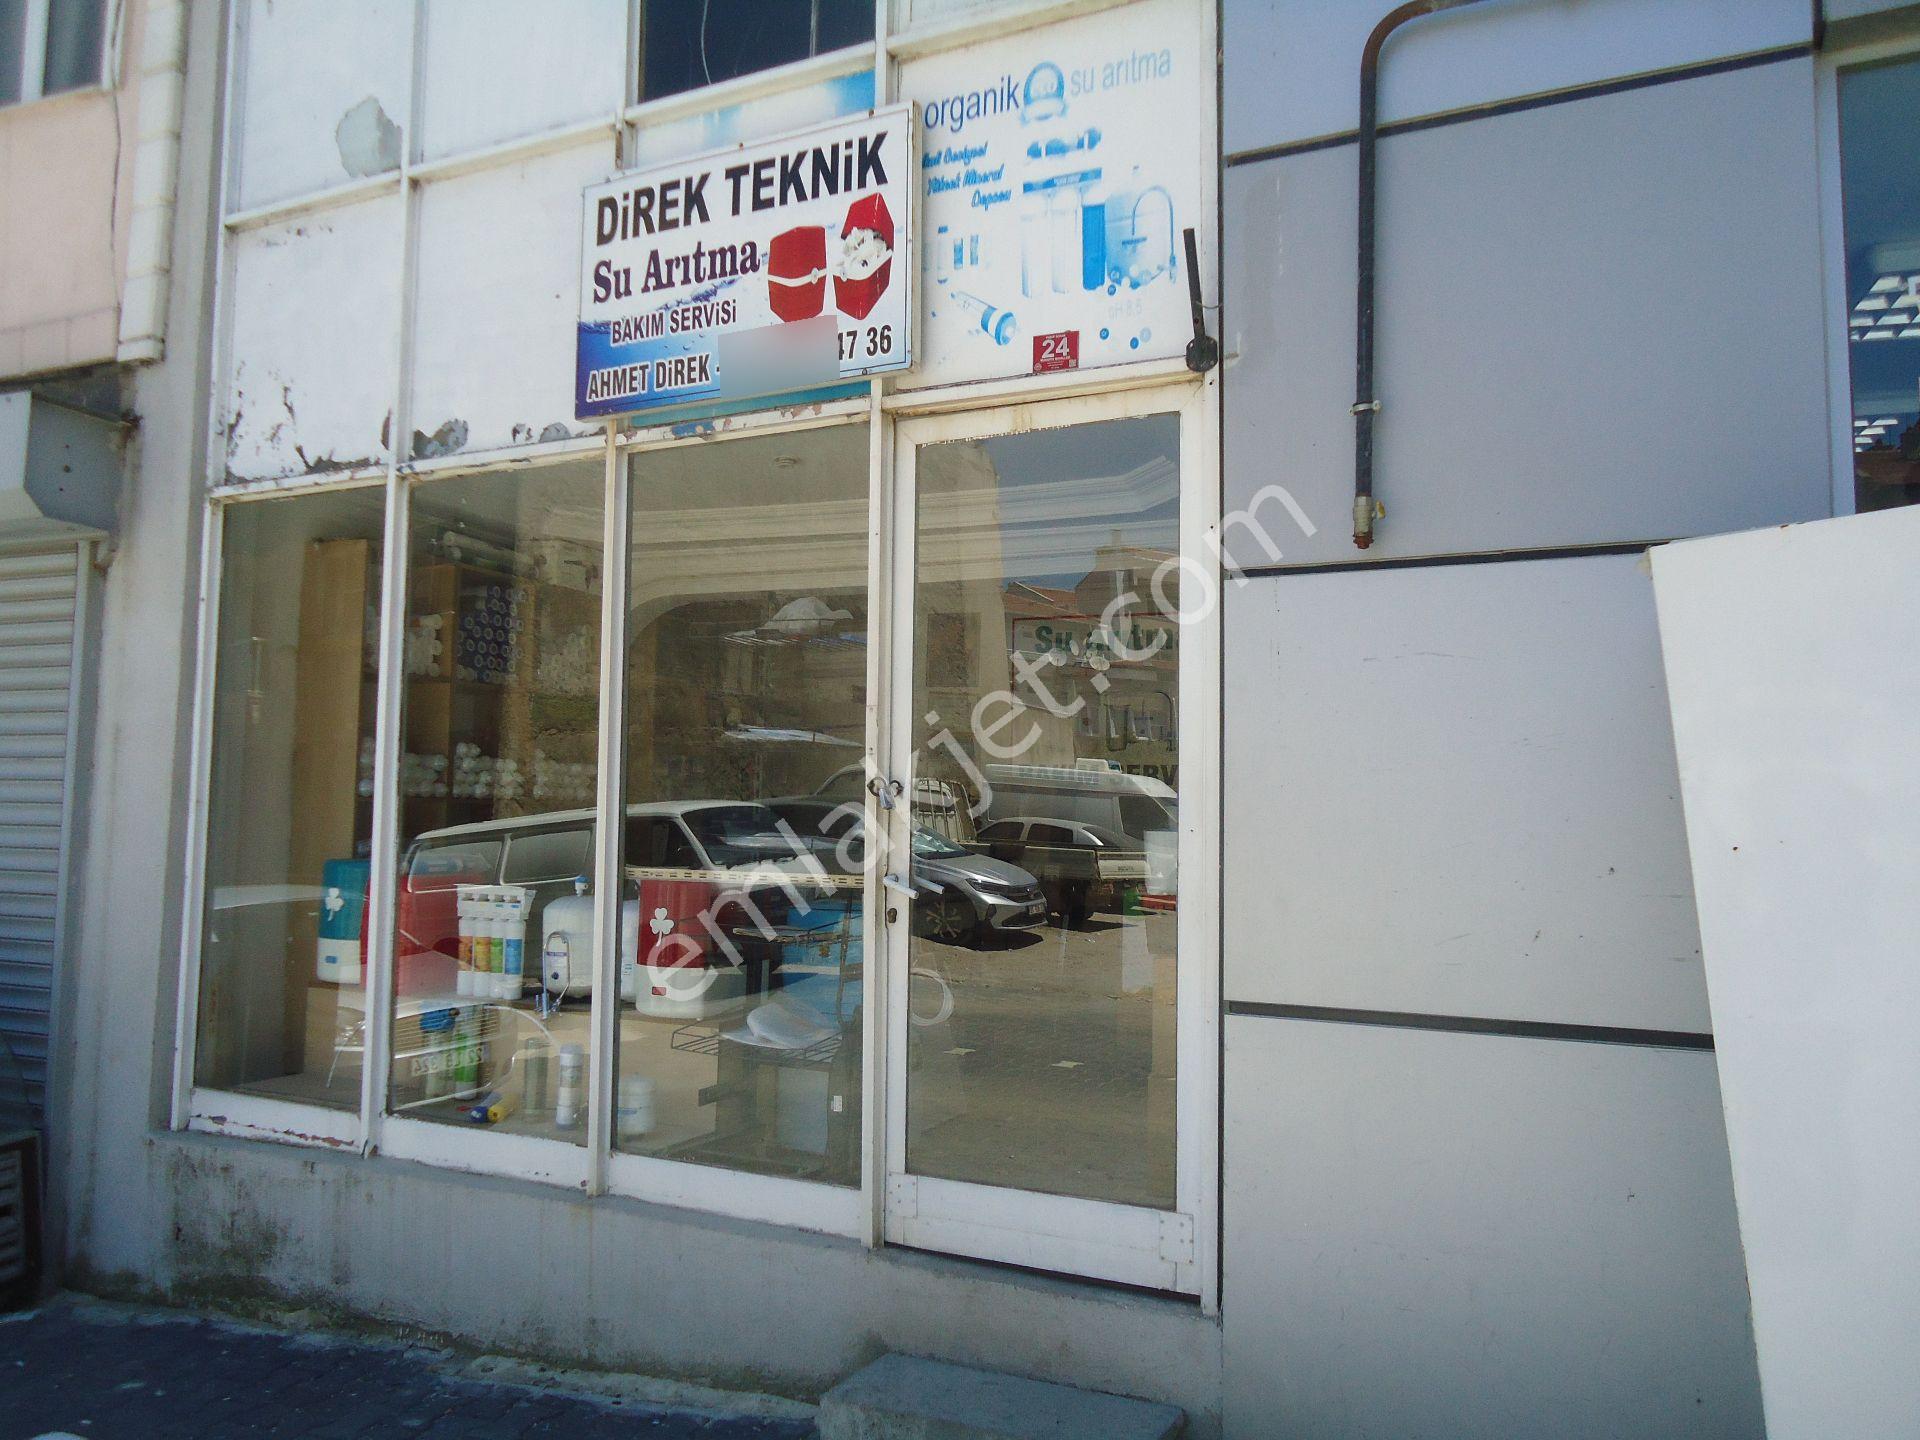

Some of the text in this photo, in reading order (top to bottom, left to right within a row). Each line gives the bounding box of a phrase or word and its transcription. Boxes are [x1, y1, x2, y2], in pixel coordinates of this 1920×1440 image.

[924, 74, 1020, 134] organik
[1070, 69, 1095, 98] su
[593, 240, 761, 304] Su Arıtma
[611, 311, 665, 345] BAKIM
[1041, 336, 1070, 359] 24
[587, 363, 649, 400] AHMET
[866, 324, 892, 357] 36
